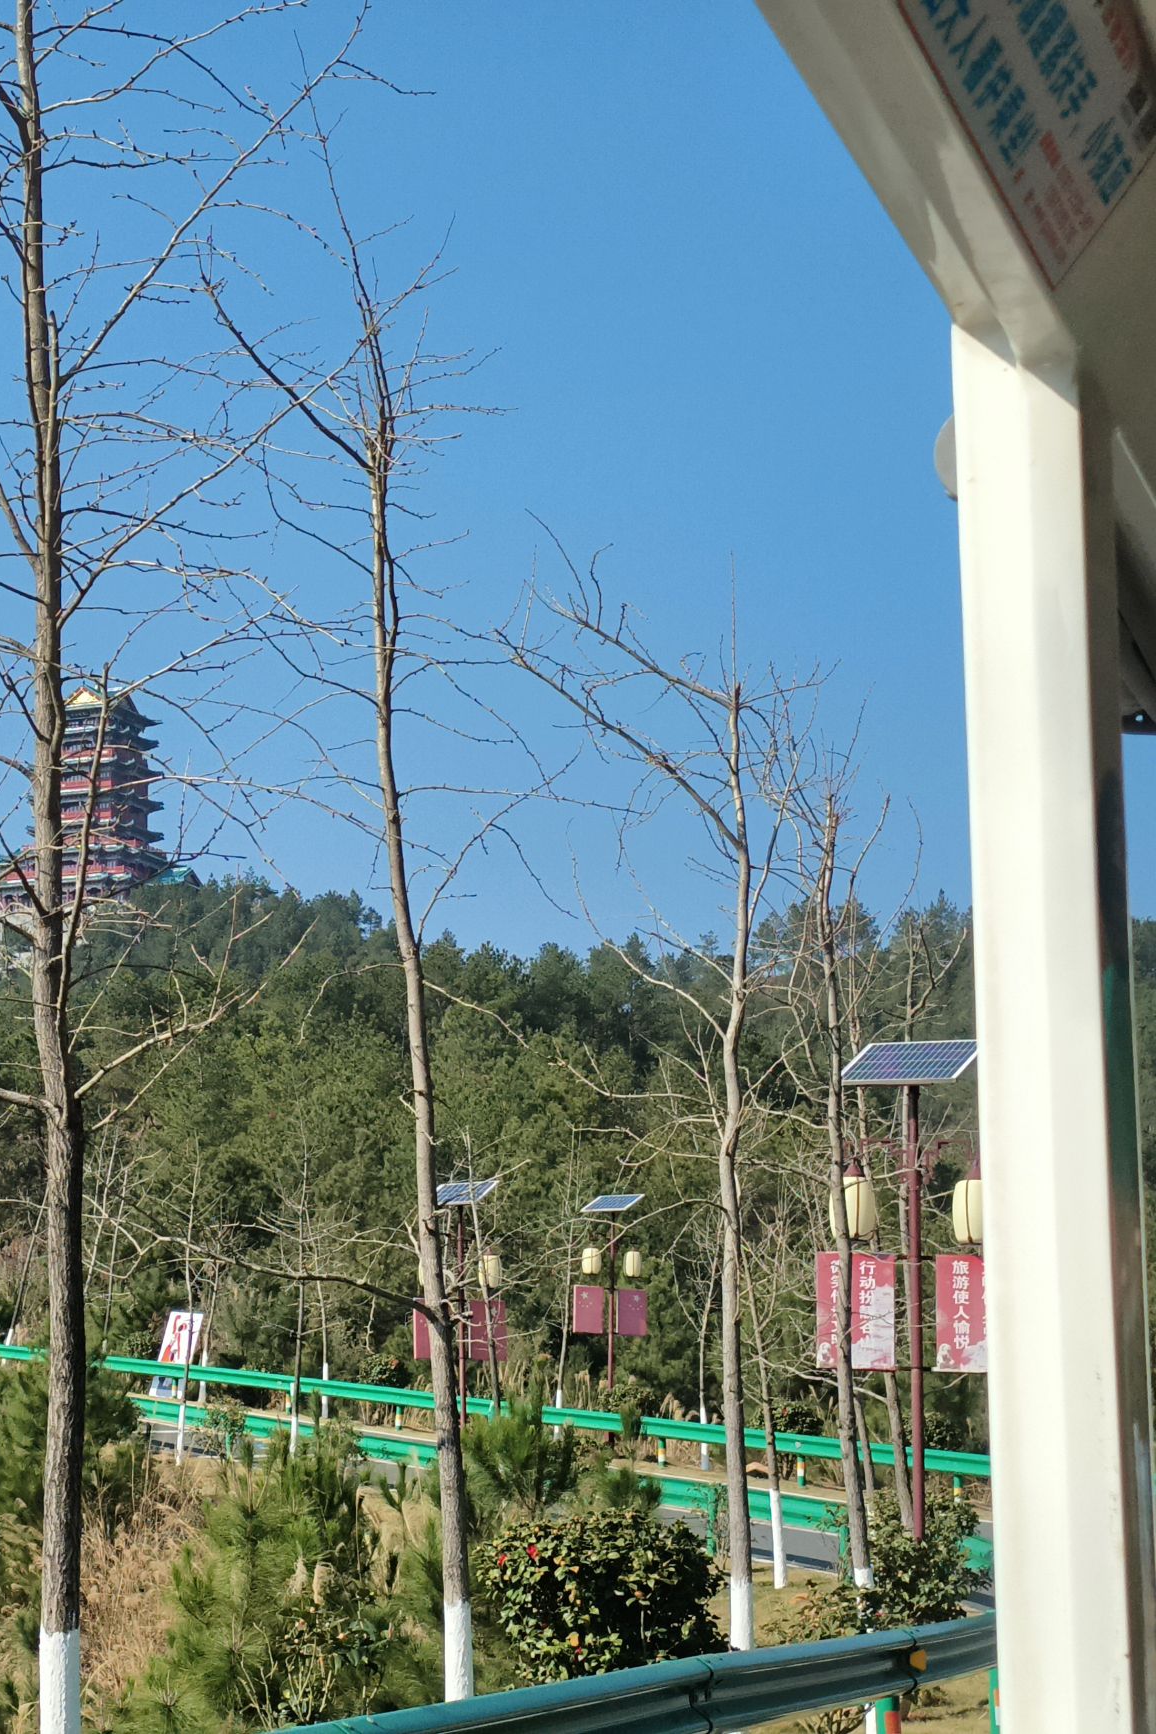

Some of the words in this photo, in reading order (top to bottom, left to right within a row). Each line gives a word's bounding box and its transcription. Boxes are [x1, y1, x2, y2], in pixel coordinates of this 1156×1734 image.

[952, 1260, 971, 1350] 旅游使人愉悦
